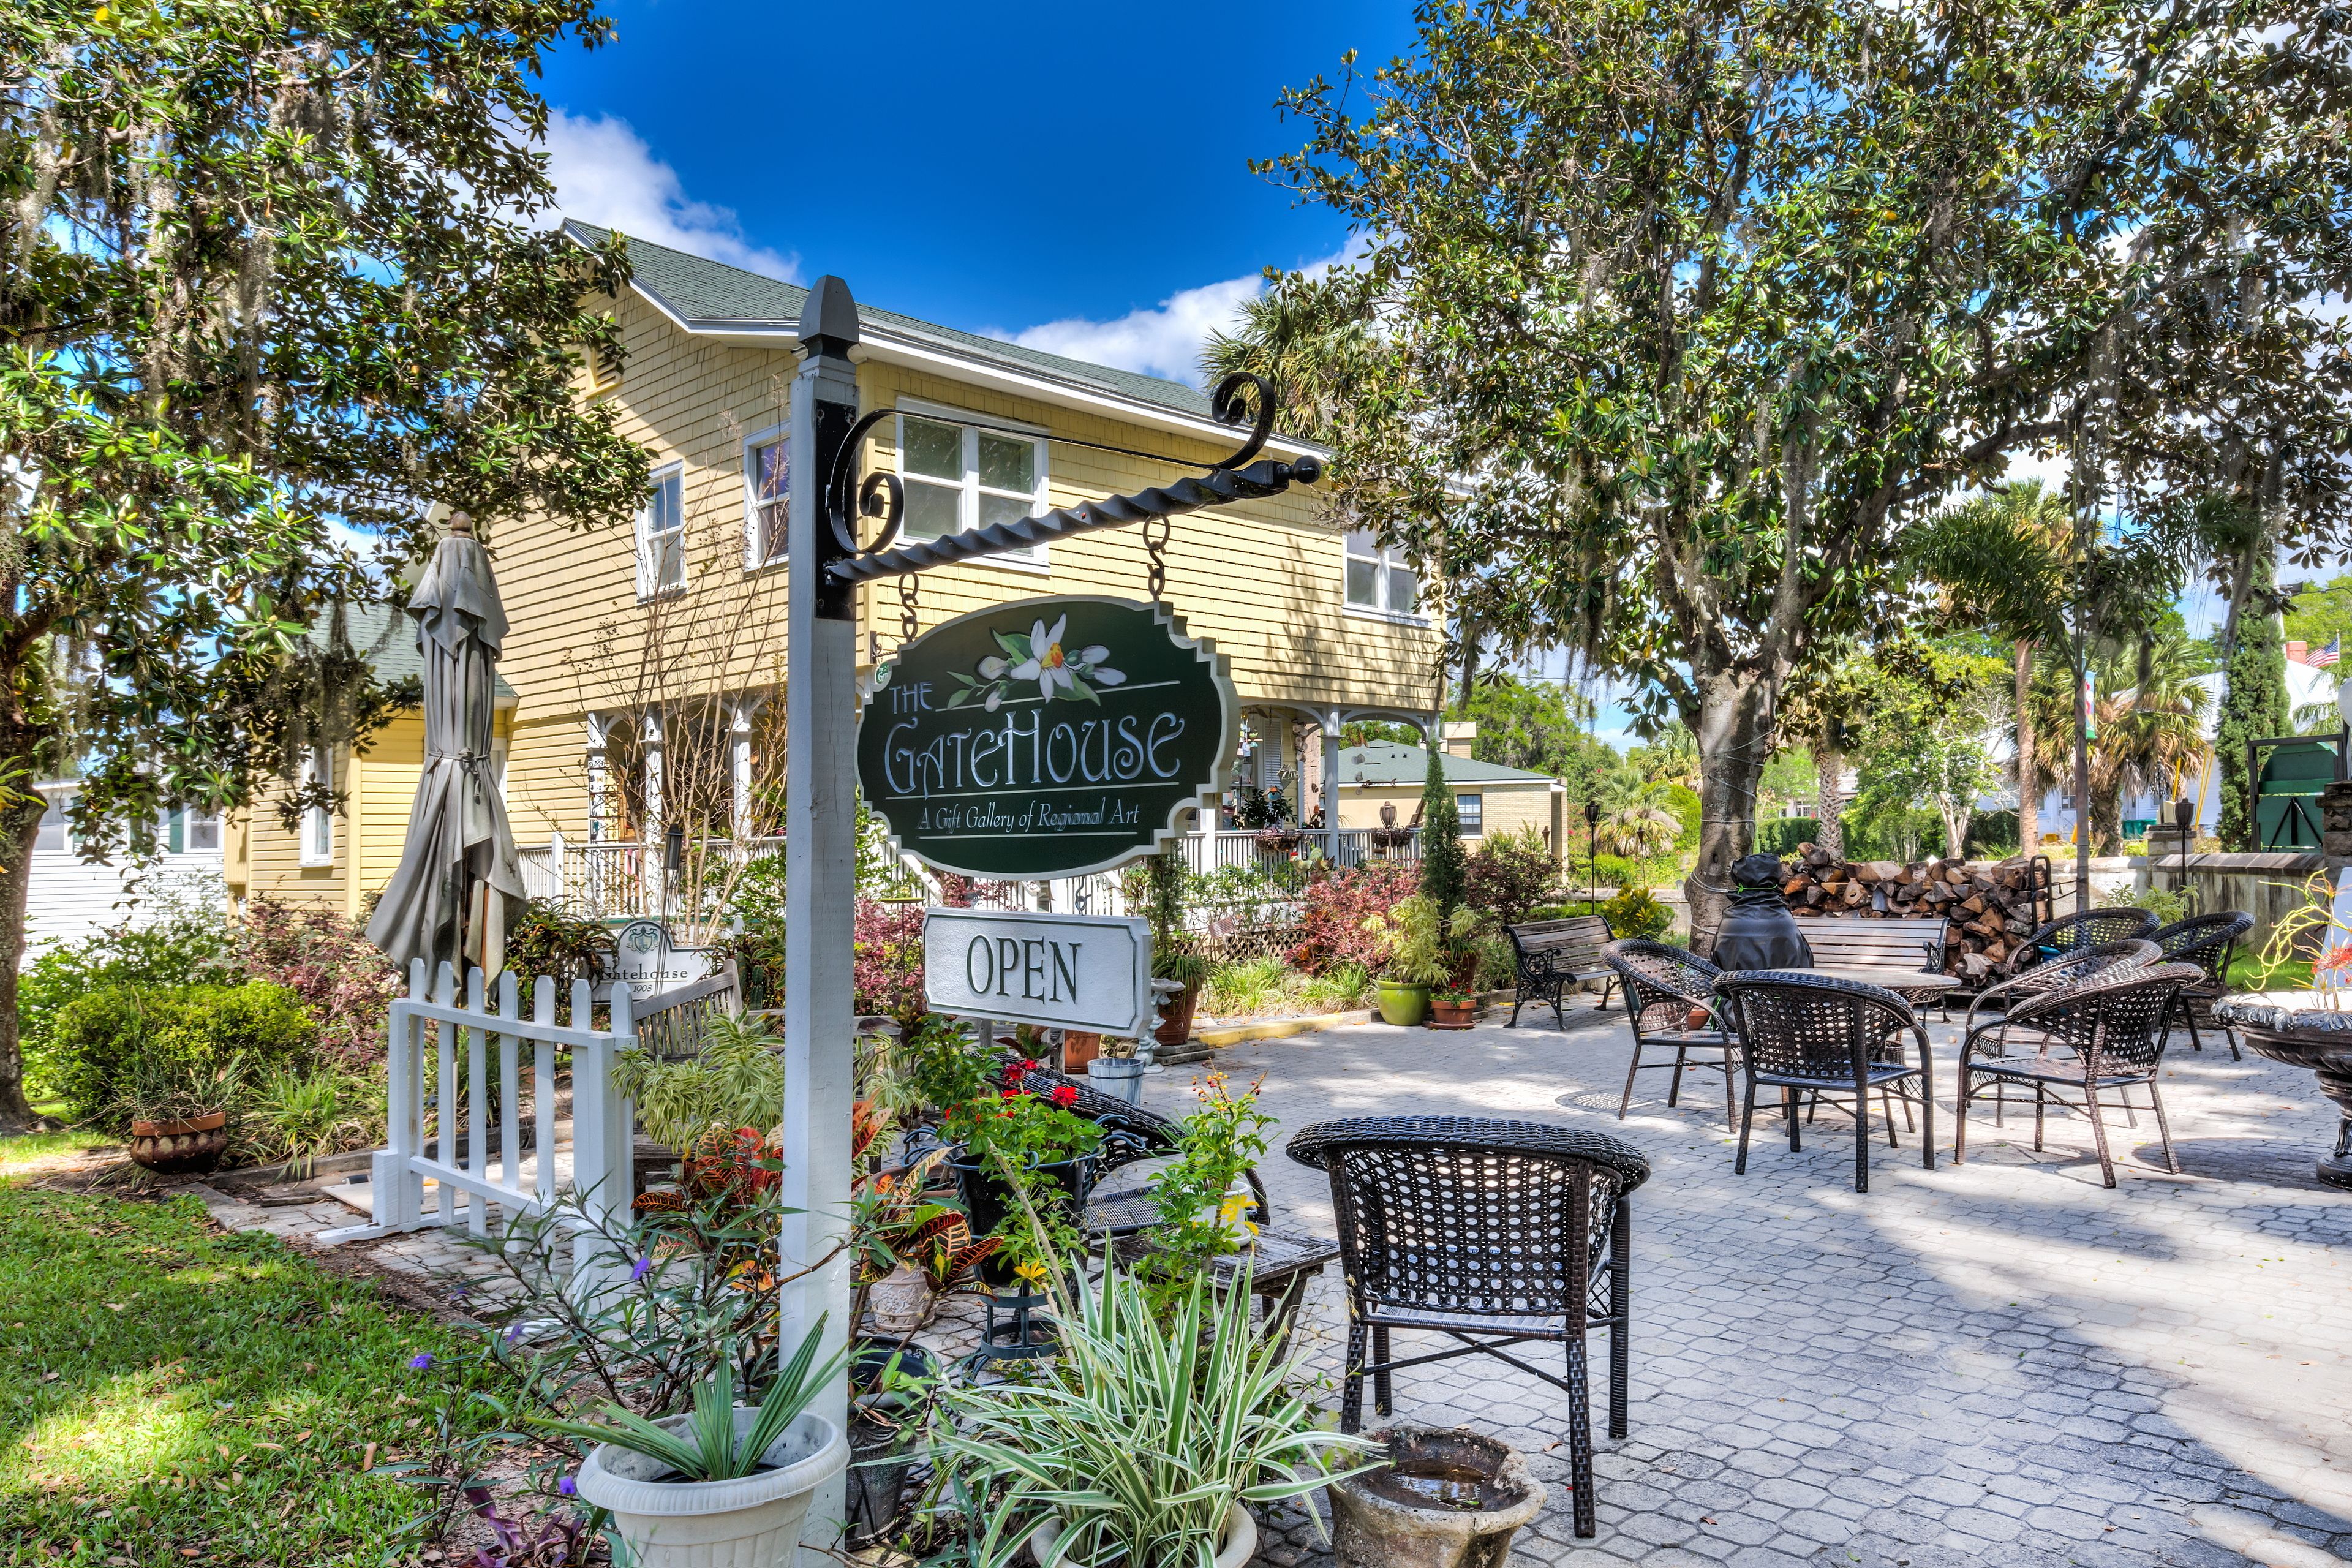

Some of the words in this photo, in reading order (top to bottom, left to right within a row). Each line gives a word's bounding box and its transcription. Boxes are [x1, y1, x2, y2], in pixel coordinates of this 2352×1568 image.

[889, 681, 933, 714] THE
[915, 807, 931, 829] A
[935, 804, 962, 834] Gift
[966, 802, 1015, 832] Gallery
[1019, 800, 1036, 832] of
[1037, 797, 1106, 832] Regional
[1107, 799, 1140, 824] Art
[967, 935, 1082, 1005] OPEN
[633, 984, 652, 993] 1908
